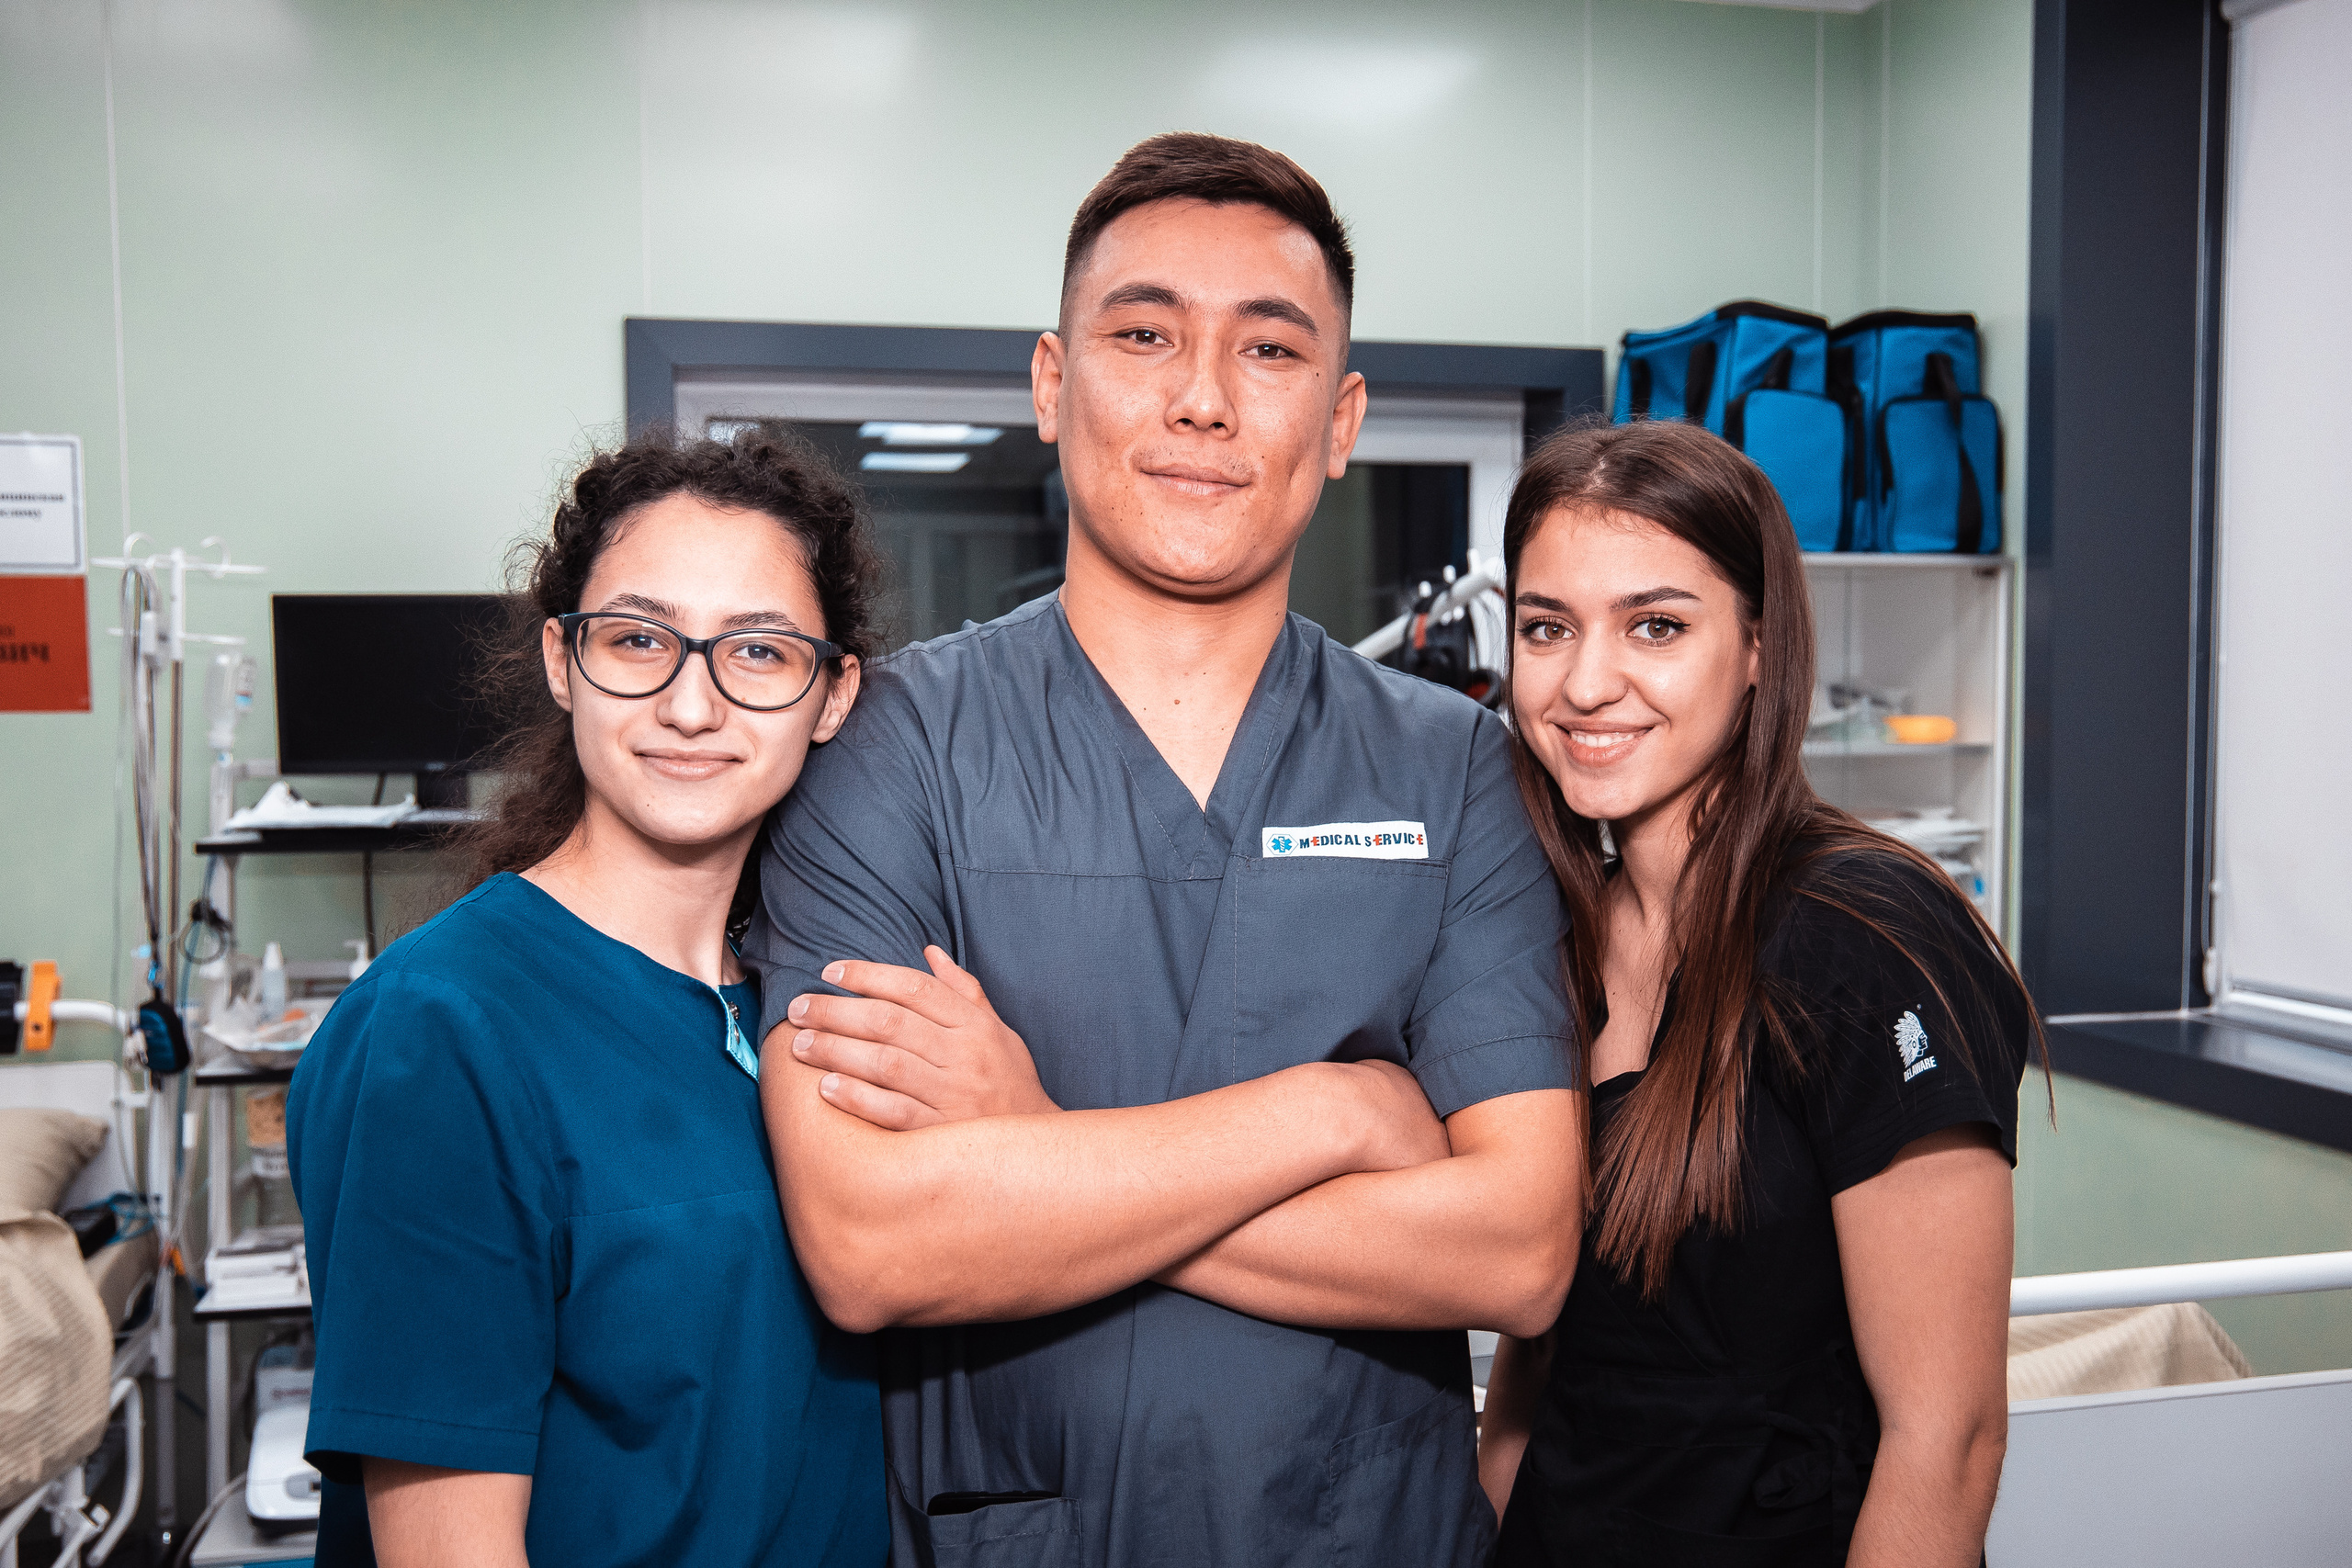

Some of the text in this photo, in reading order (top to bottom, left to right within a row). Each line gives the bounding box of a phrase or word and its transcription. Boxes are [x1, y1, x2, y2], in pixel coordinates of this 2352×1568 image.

[1299, 832, 1424, 849] MEDICAL SERVICE
[1904, 1055, 1937, 1082] DELAWARE
